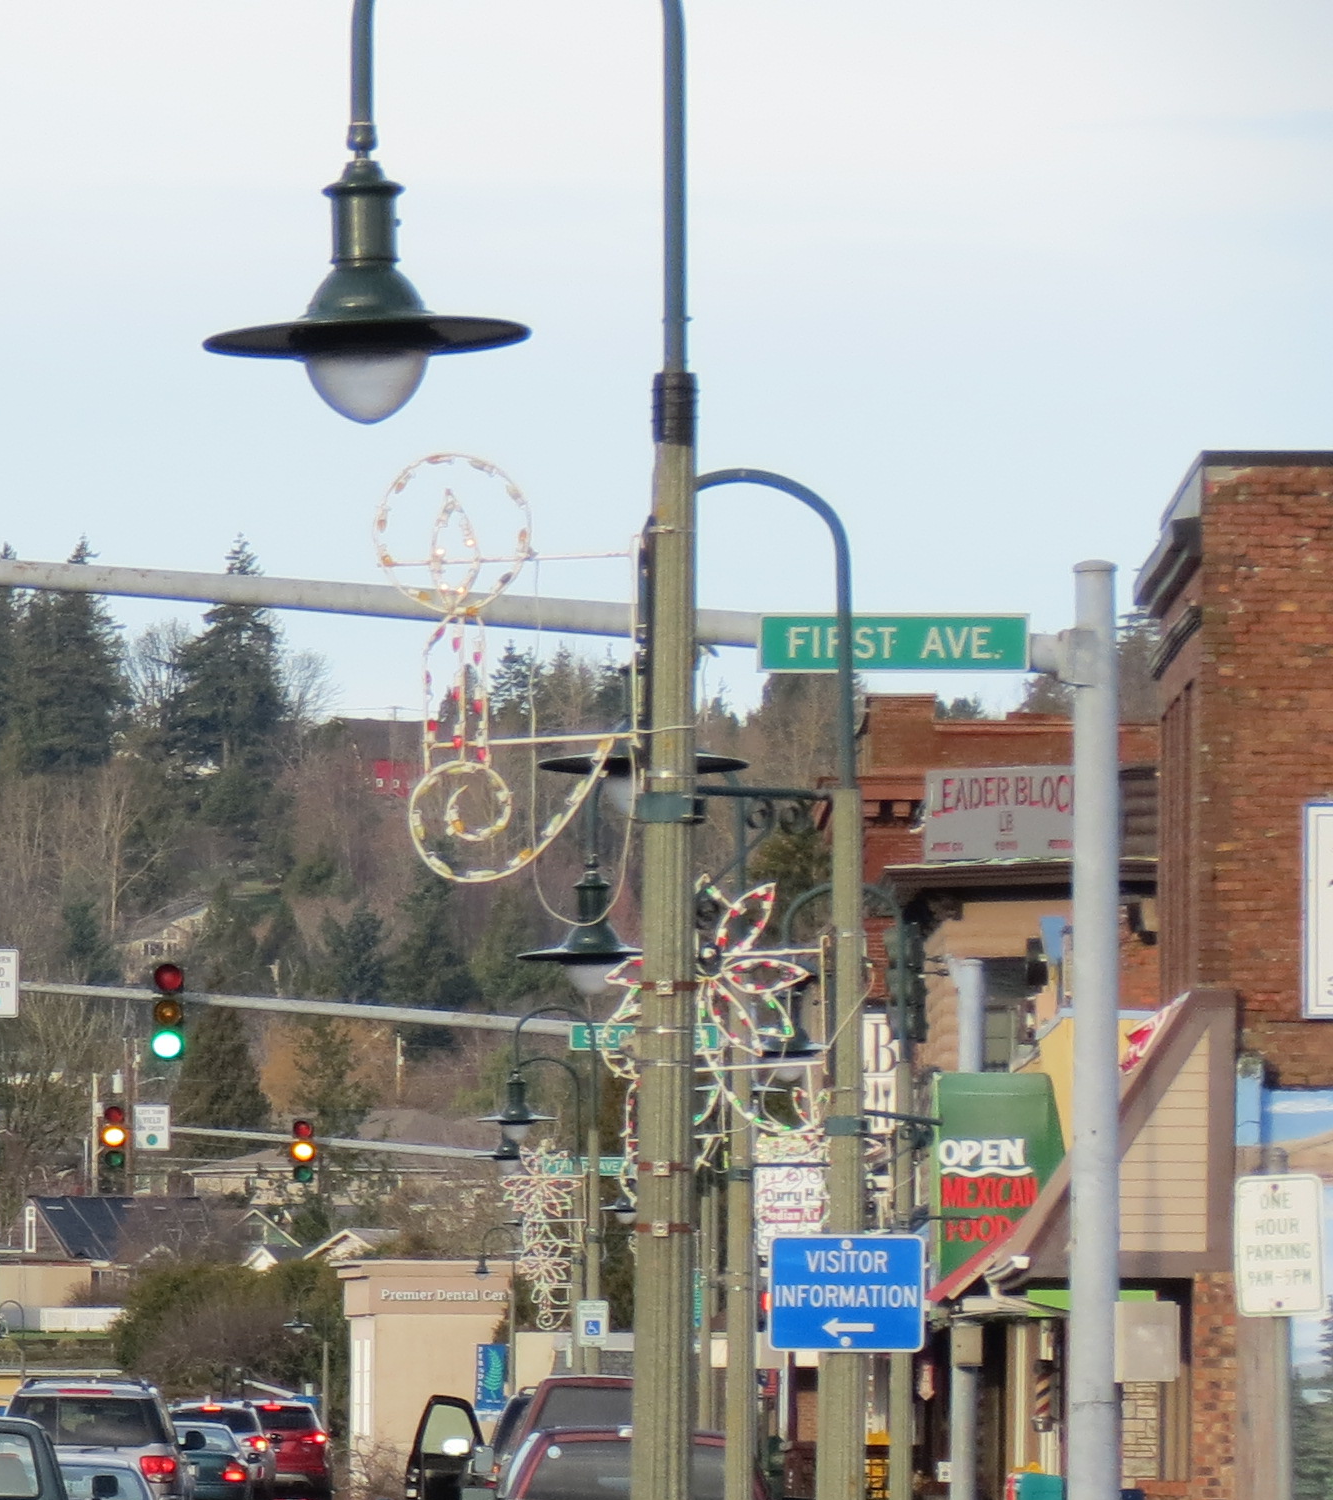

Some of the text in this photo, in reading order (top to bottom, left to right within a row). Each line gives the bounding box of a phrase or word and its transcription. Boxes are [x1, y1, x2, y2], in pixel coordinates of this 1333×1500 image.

[787, 626, 898, 659] FIRST
[931, 775, 1074, 818] LEADER BLOC
[938, 1138, 1025, 1167] OPEN
[940, 1175, 1039, 1209] MEXICAN
[1259, 1192, 1293, 1210] ONE
[1254, 1218, 1301, 1236] HOUR
[804, 1250, 889, 1274] VISITOR
[1245, 1242, 1312, 1262] PARKING
[380, 1288, 434, 1301] Premier
[436, 1288, 479, 1301] Dental
[774, 1284, 918, 1308] INFORMATION
